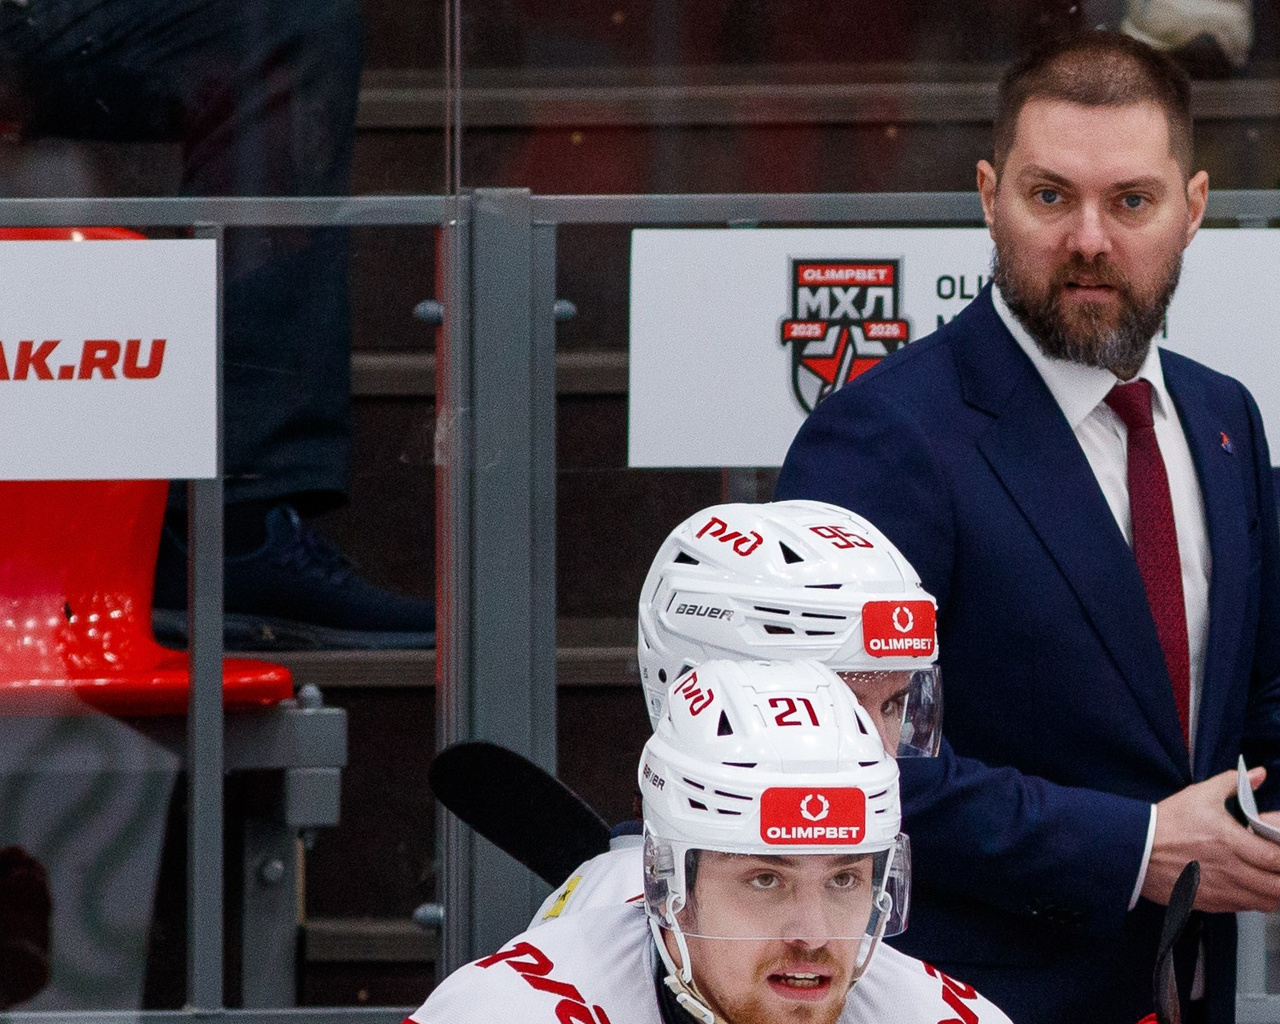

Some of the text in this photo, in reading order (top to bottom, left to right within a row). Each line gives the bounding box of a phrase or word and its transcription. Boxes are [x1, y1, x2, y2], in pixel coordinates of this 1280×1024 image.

[803, 268, 888, 282] OLIMPBET
[798, 287, 893, 319] МХЛ
[809, 525, 874, 549] 95
[869, 638, 932, 650] OLIMPBET
[768, 697, 820, 727] 21
[766, 826, 860, 840] OLIMPBET
